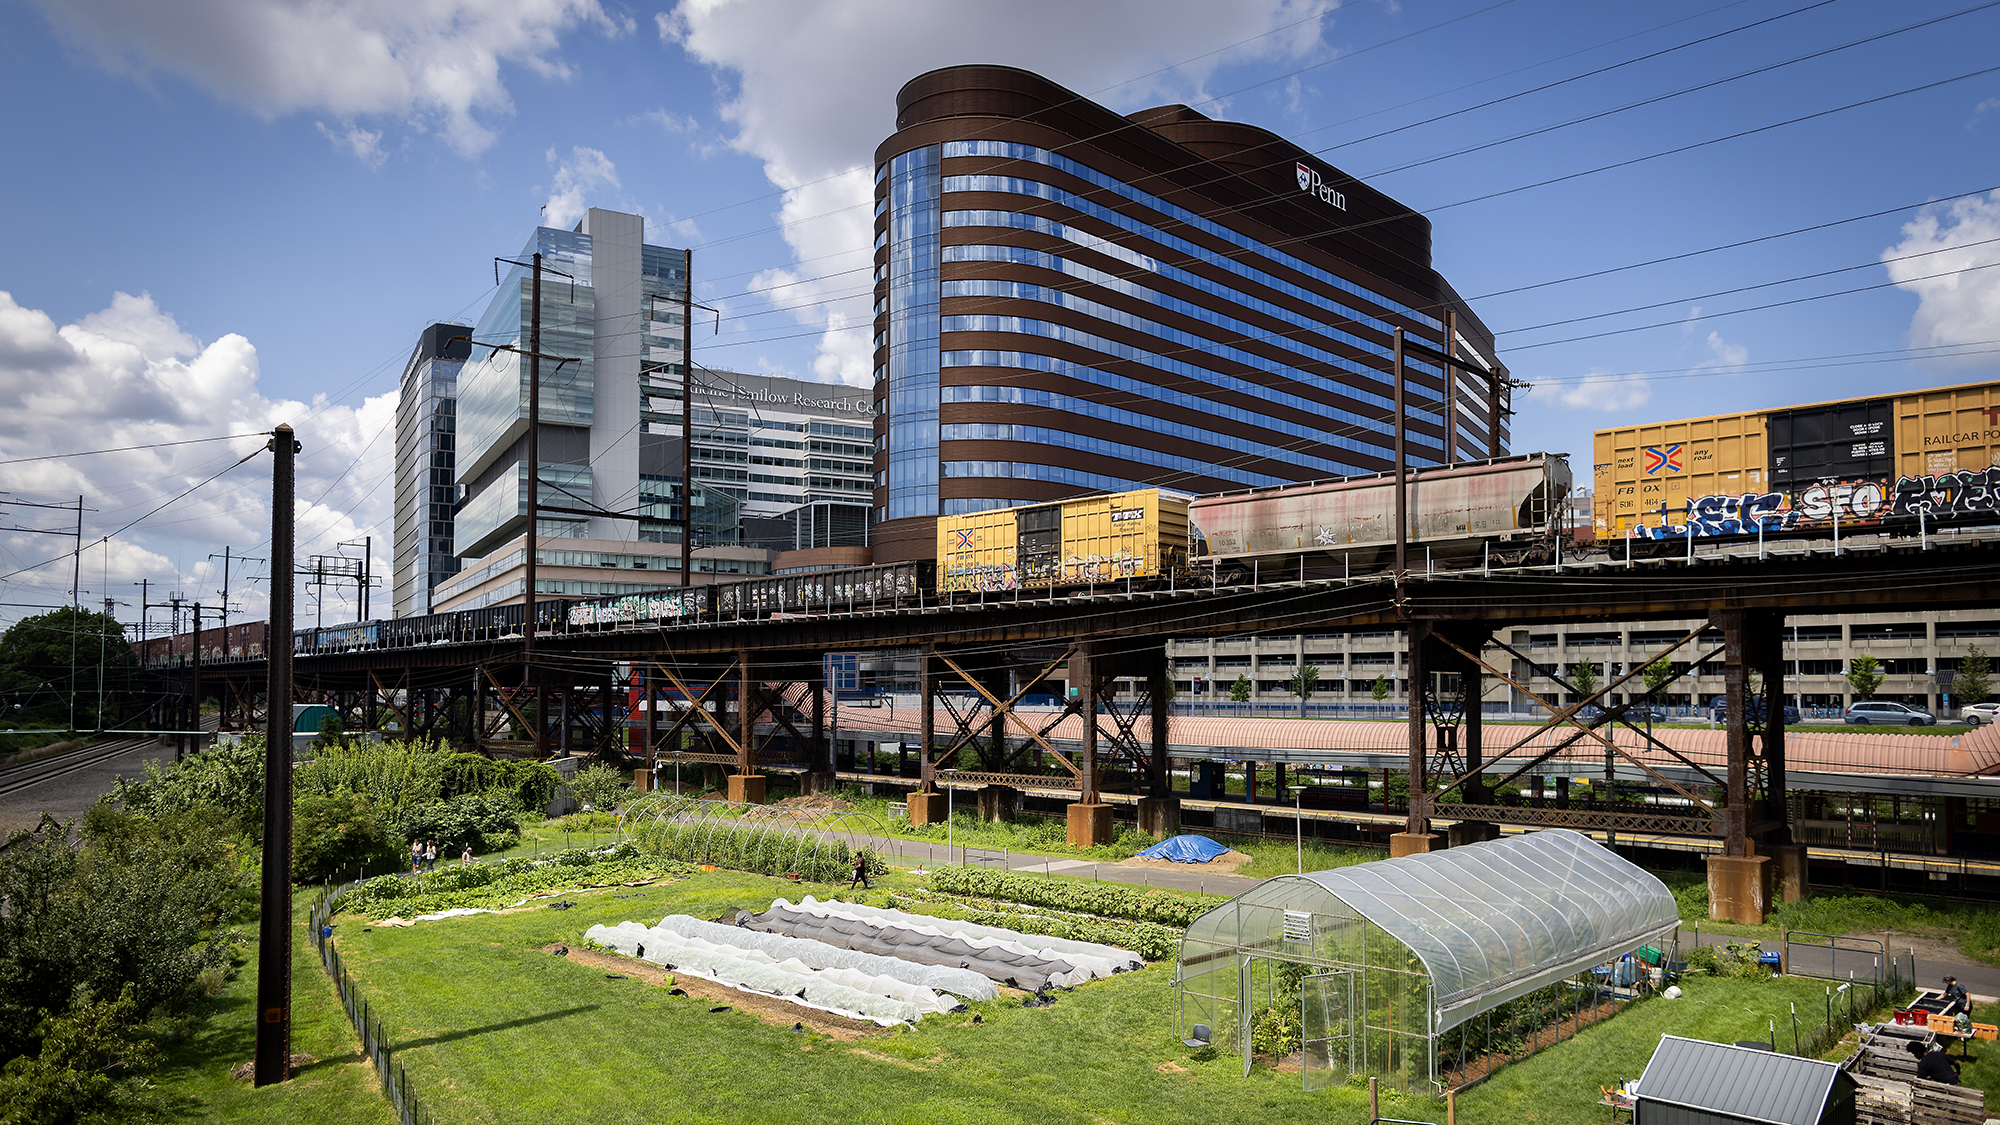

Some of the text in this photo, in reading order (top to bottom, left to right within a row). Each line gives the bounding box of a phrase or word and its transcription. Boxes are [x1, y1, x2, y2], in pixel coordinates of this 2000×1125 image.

[1310, 169, 1347, 212] Penn
[738, 384, 789, 404] Smilow
[793, 392, 851, 412] Research
[1924, 431, 1979, 446] RAILCAR
[1617, 487, 1635, 495] FB
[1619, 500, 1634, 508] 506
[1801, 483, 1883, 520] SFO
[1218, 538, 1237, 547] 10353
